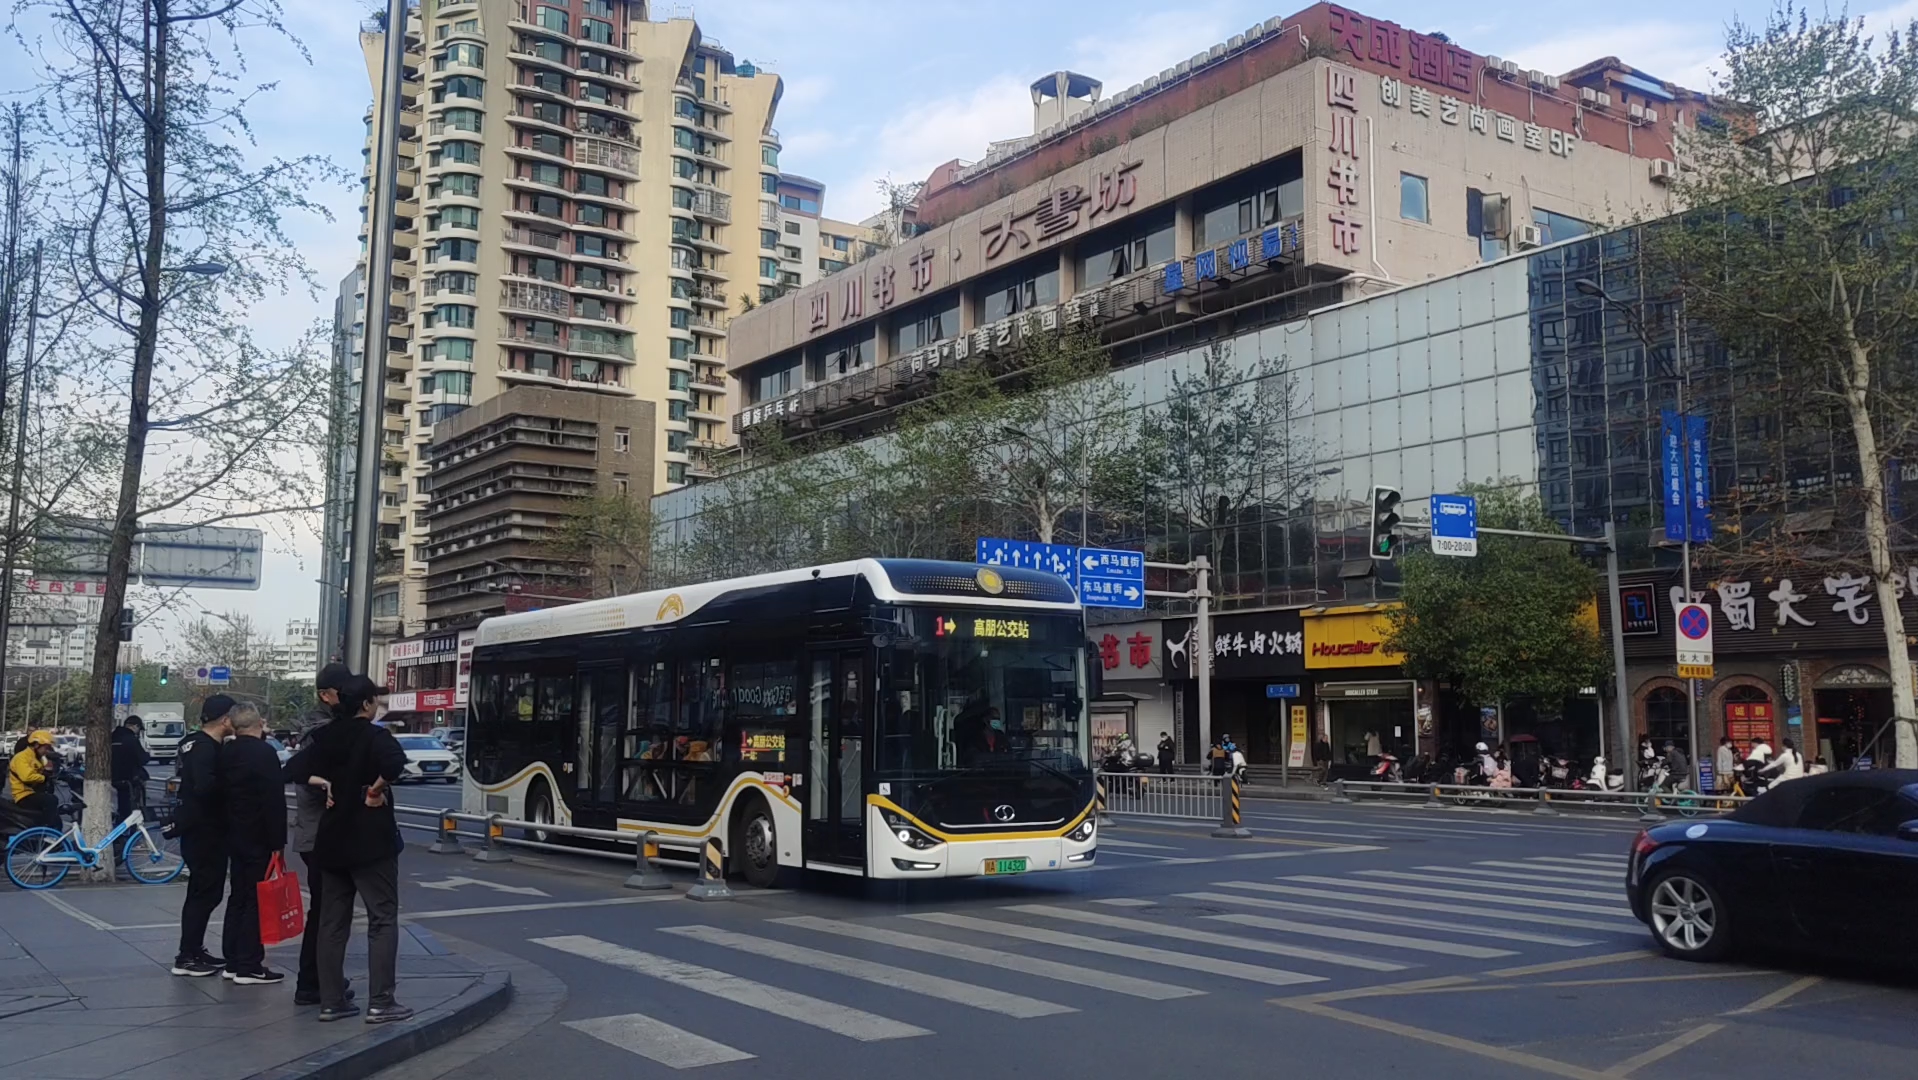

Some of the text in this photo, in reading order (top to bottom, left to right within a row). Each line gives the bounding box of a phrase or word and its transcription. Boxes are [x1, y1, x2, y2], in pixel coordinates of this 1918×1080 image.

[1330, 5, 1473, 93] 天成酒店
[1380, 76, 1575, 158] 创美艺尚画室5F
[1327, 66, 1361, 256] 四川书市
[1437, 540, 1472, 552] 7:00-20:00
[1100, 554, 1140, 567] 西马道街
[1083, 581, 1123, 595] 东马道街
[935, 616, 945, 636] 1
[973, 618, 1030, 639] 高朋公交站
[1099, 630, 1153, 670] 书市
[1214, 631, 1303, 658] 鲜牛肉火锅
